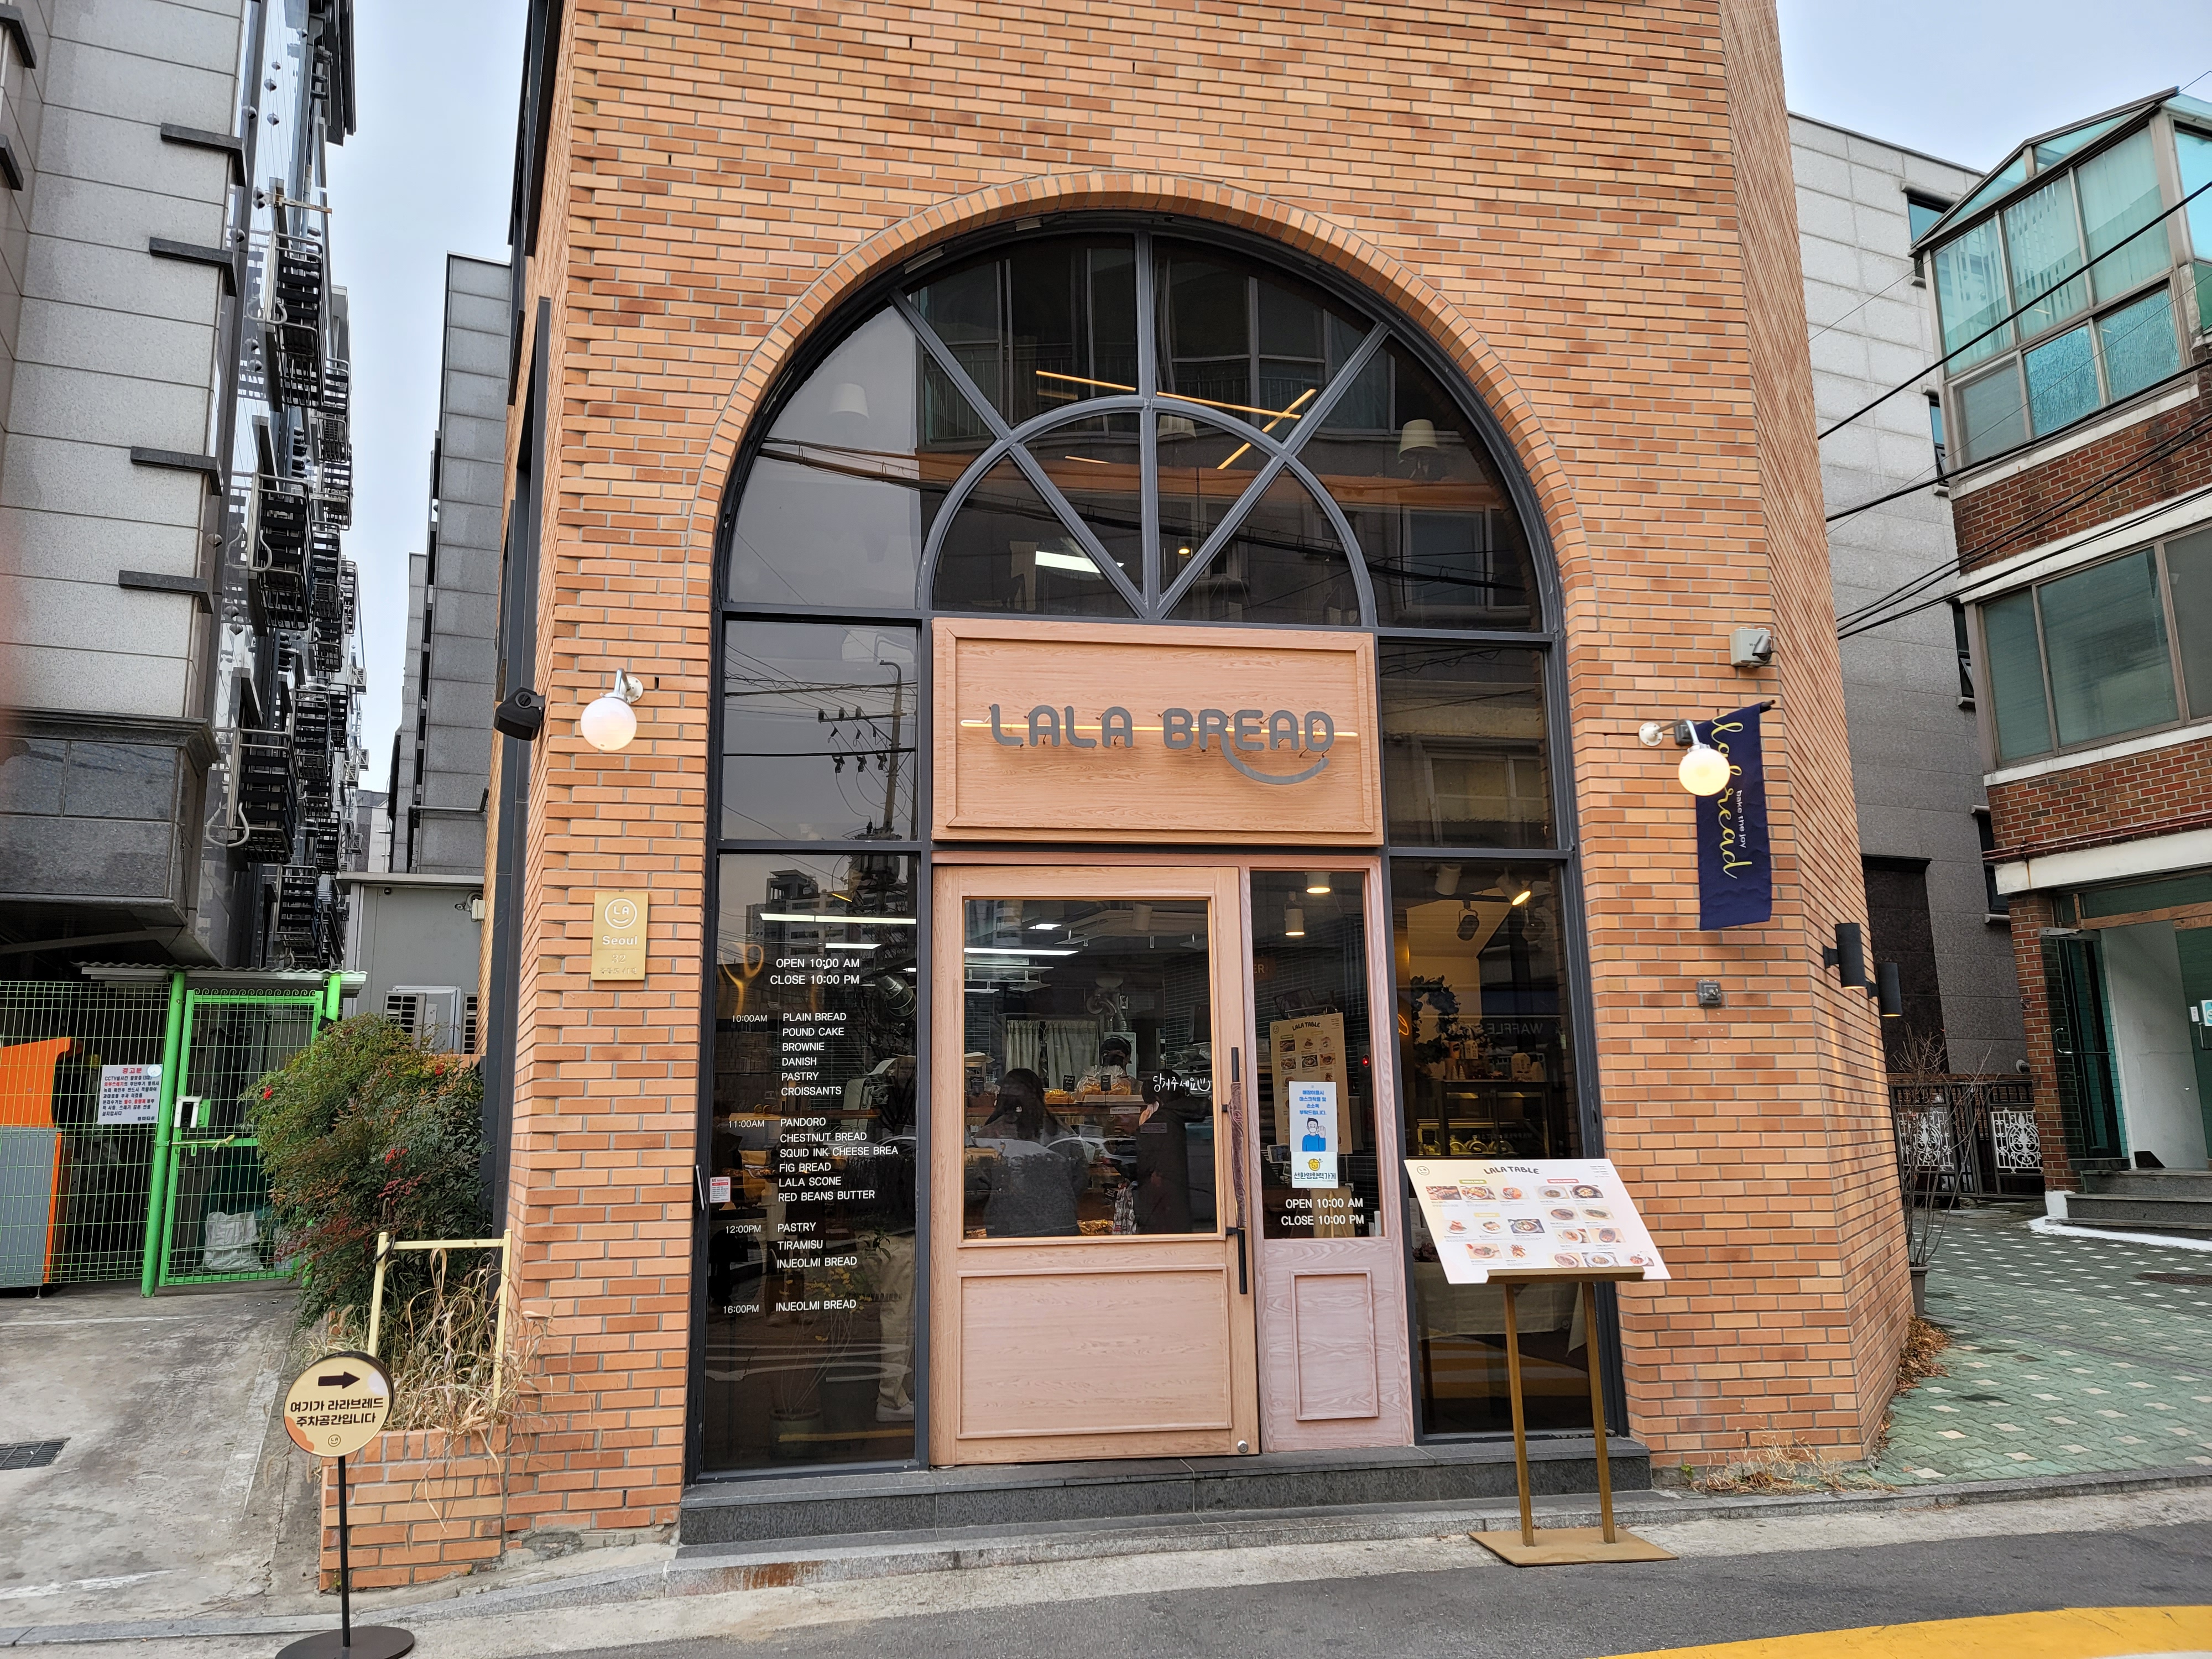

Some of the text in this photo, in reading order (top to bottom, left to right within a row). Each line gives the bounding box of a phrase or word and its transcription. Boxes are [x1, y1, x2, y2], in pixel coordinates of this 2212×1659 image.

[991, 704, 1334, 785] LALA BREAD
[613, 906, 629, 915] LA
[602, 936, 638, 945] Seoul
[612, 954, 626, 963] 32
[776, 958, 859, 968] OPEN 10:00 AM
[770, 975, 859, 984] CLOSE 10:00 PM
[782, 1028, 815, 1036] POUND
[782, 1042, 825, 1051] BROWNIE
[782, 1057, 817, 1066] DANISH
[782, 1072, 819, 1081] PASTRY
[1153, 1073, 1198, 1092] 당겨주세요
[781, 1087, 841, 1096] CROISSANTS
[780, 1118, 826, 1127] PANDORO
[780, 1133, 867, 1142] CHESTNUT BREAD
[780, 1146, 898, 1158] SQUID INK CHEESE BREA
[780, 1163, 831, 1172] FIG BREAD
[1483, 1166, 1540, 1175] LALA TABLE
[779, 1177, 841, 1187] LALA SCONE
[778, 1190, 875, 1202] RED BEANS BUTTER
[1286, 1198, 1363, 1208] OPEN 10:00 AM
[1281, 1215, 1364, 1225] CLOSE 10:00 PM
[726, 1225, 761, 1234] 12:00PM
[778, 1223, 816, 1233] PASTRY
[778, 1240, 823, 1250] TIRAMISU
[777, 1257, 857, 1269] INJEOLMI BREAD
[723, 1305, 759, 1314] 16:00PM
[776, 1300, 856, 1312] INJEOLMI BREAD
[290, 1397, 384, 1412] 여기가 라라브레드
[296, 1412, 376, 1427] 주차공간입니다
